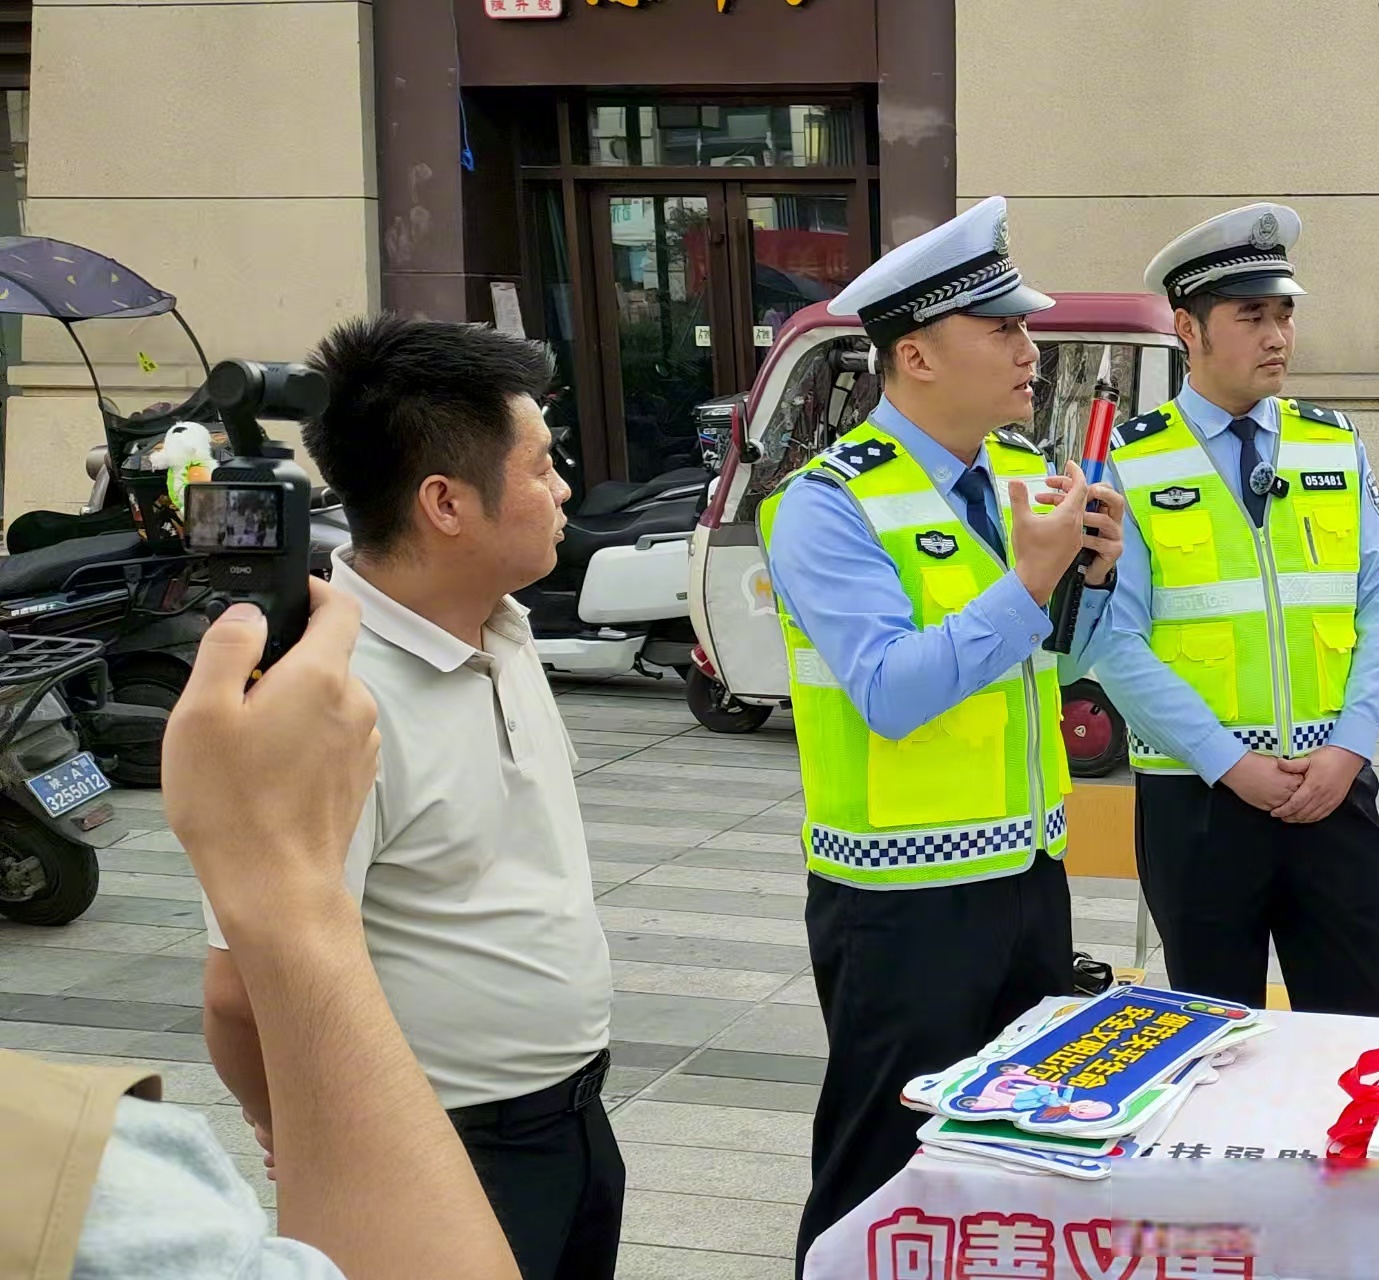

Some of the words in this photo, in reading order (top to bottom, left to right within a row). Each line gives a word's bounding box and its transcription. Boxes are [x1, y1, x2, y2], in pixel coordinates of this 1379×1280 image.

[1305, 475, 1343, 487] 053481
[46, 773, 105, 811] 3255012
[1026, 1005, 1155, 1083] 安全文明出行
[1068, 1012, 1196, 1089] 细节关乎生命
